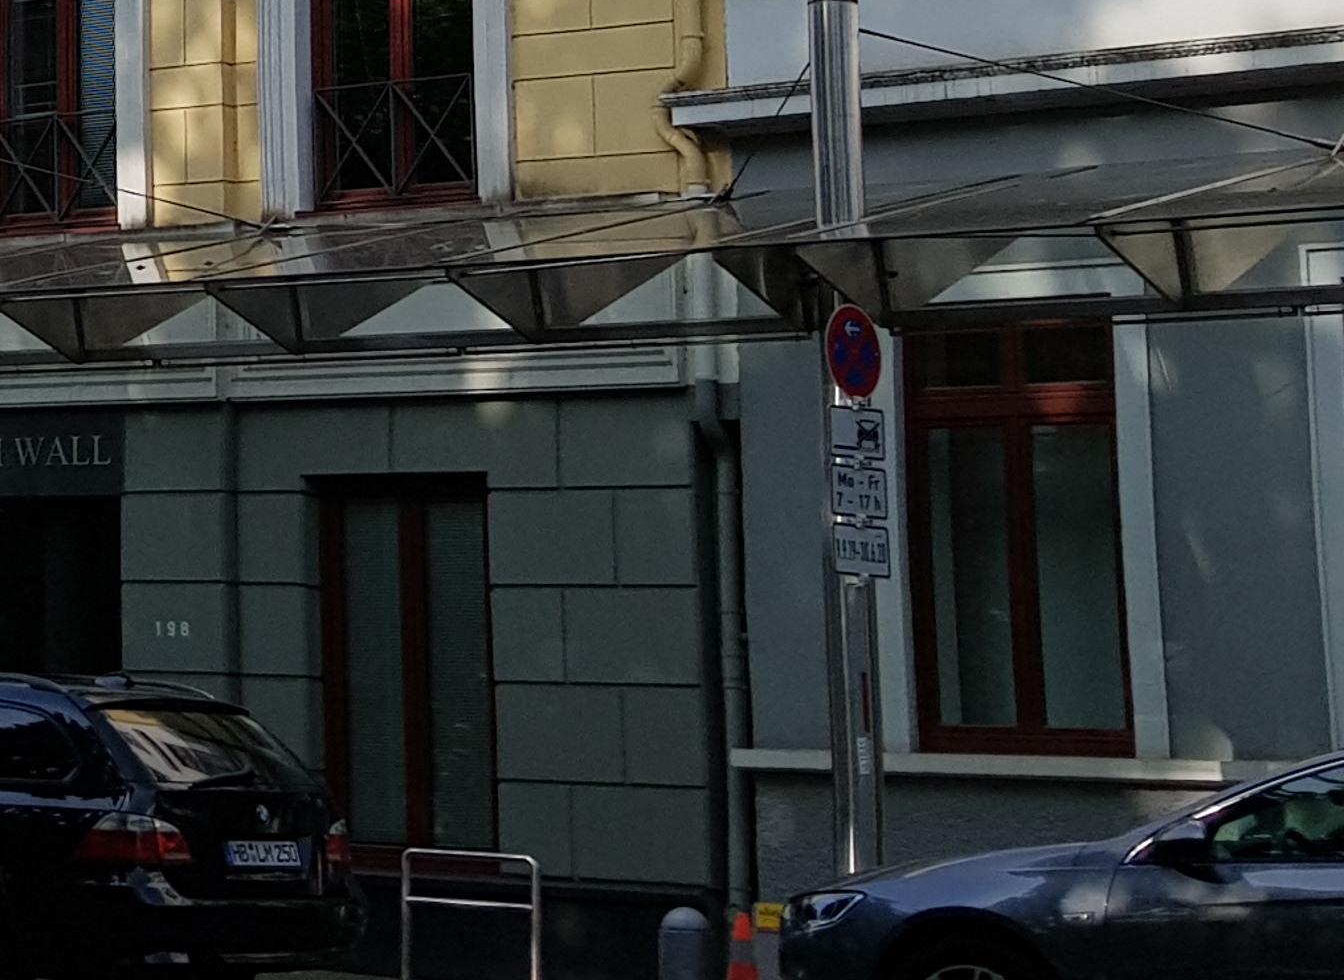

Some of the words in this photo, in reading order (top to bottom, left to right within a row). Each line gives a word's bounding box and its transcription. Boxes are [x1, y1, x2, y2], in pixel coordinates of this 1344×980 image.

[13, 435, 113, 467] WALL
[838, 472, 855, 487] Mo
[868, 475, 880, 490] Fr
[837, 492, 843, 506] 7
[859, 495, 870, 510] 17
[874, 496, 881, 510] h
[155, 620, 190, 637] 198
[233, 844, 249, 862] HB
[275, 844, 298, 862] 250
